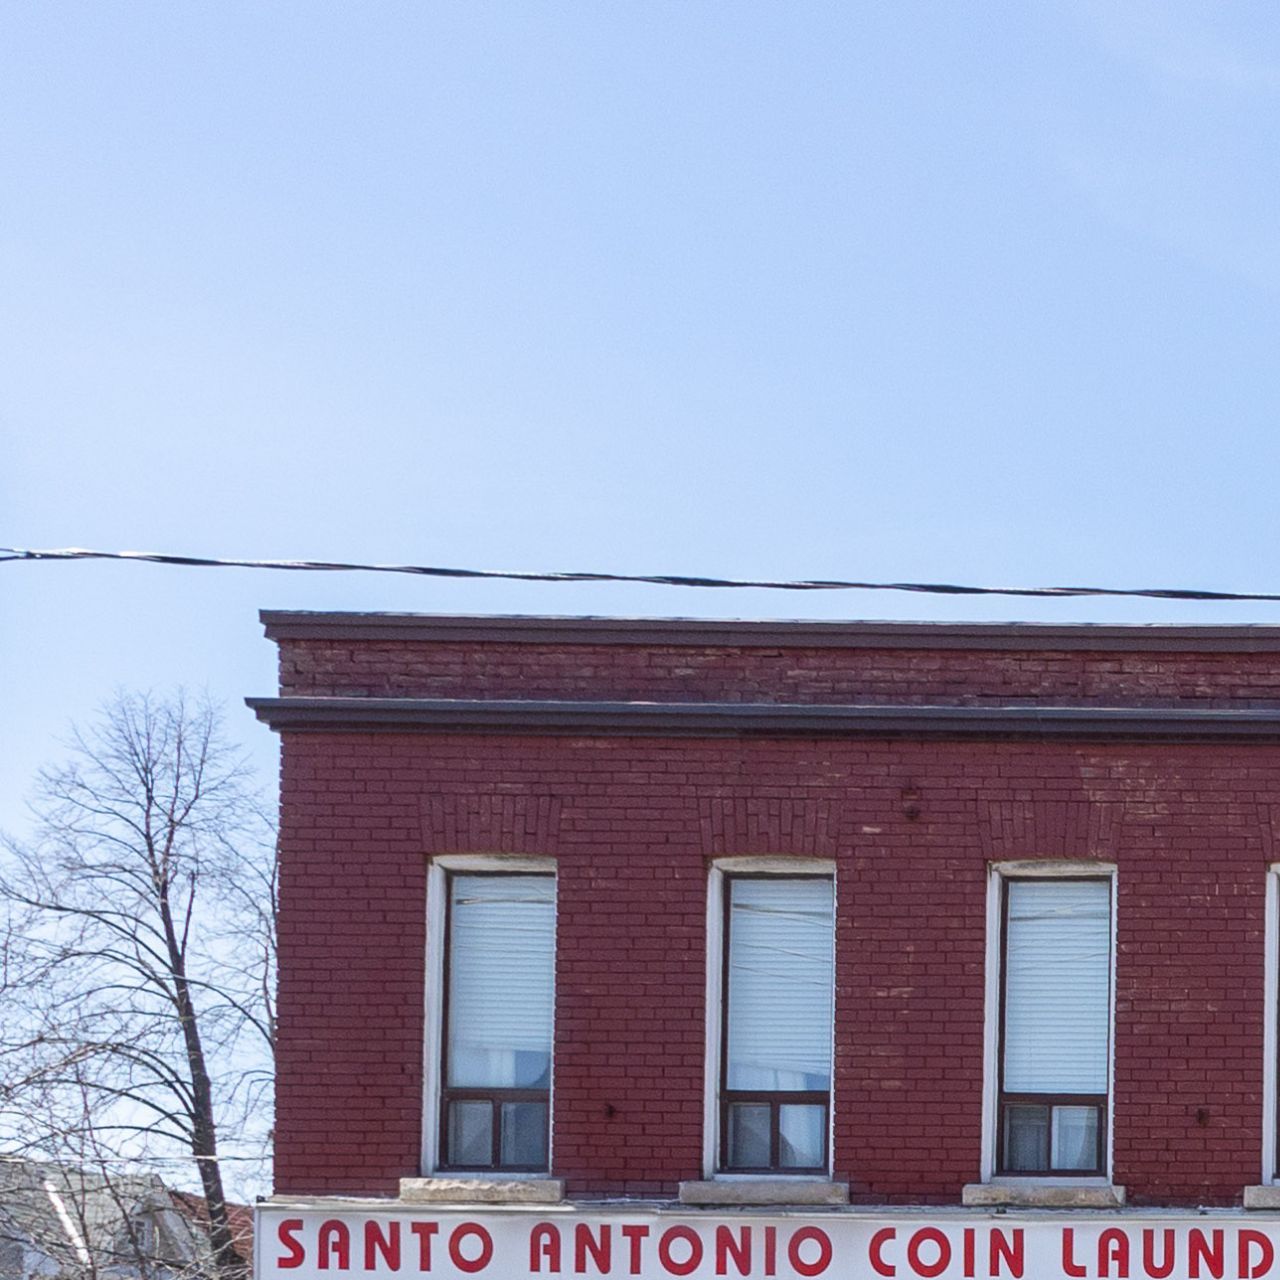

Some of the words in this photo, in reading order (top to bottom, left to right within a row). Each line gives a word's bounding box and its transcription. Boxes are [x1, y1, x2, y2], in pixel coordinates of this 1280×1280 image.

[278, 1219, 494, 1273] SANTO
[529, 1223, 834, 1277] ANTONIO
[869, 1227, 1025, 1279] COIN
